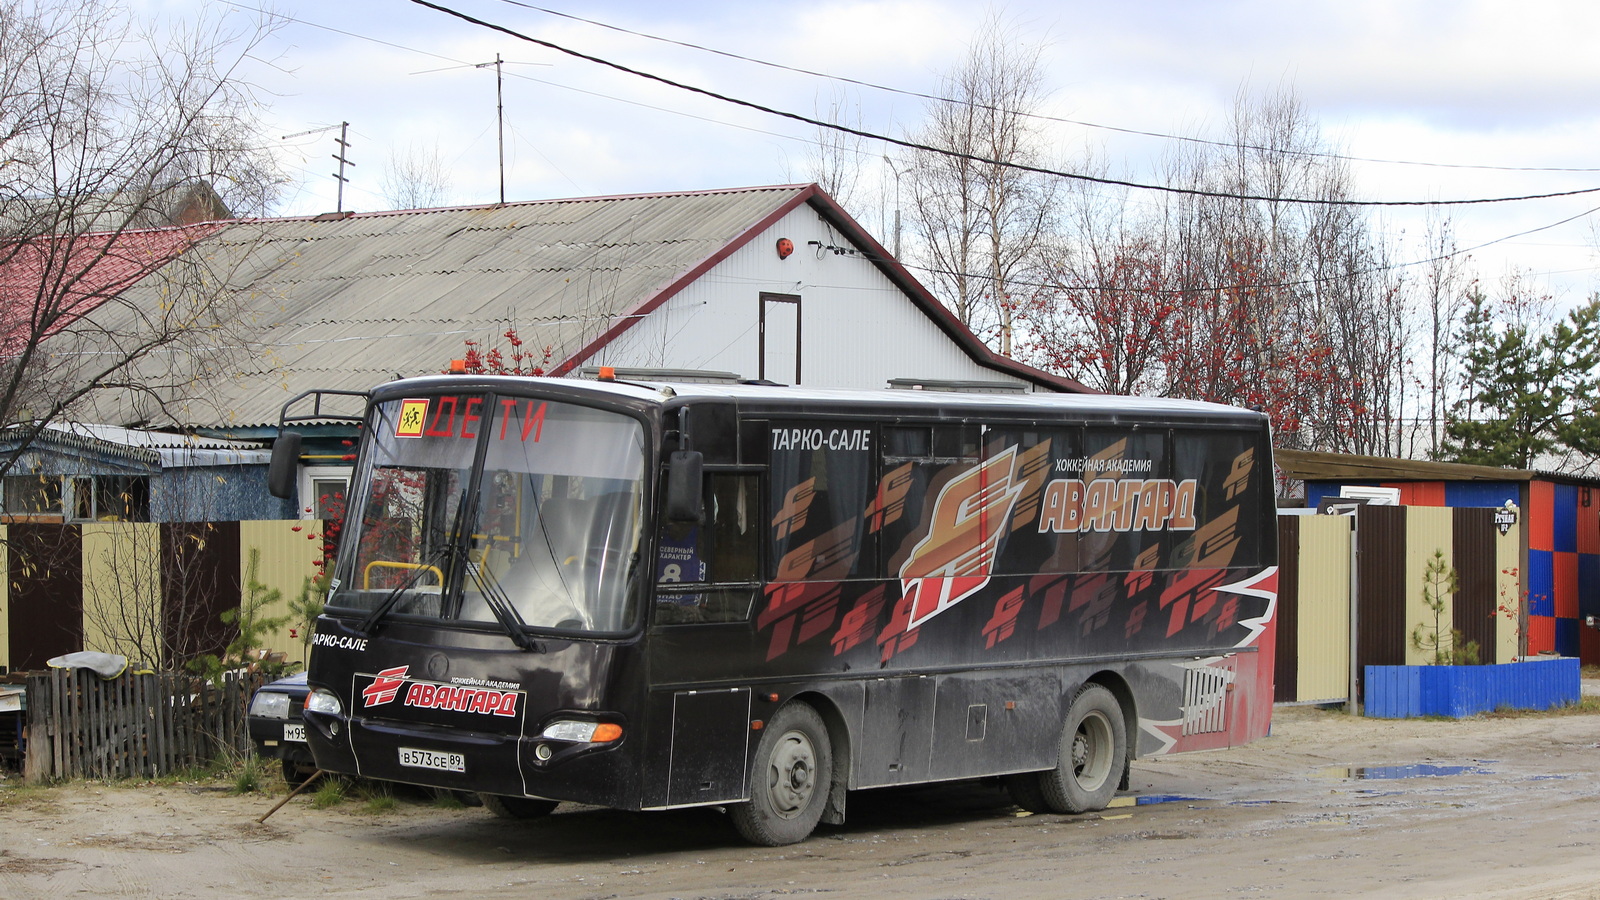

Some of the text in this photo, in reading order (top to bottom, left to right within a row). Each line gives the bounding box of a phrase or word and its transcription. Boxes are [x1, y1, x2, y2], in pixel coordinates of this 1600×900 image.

[425, 396, 548, 443] ДЕТИ
[772, 428, 871, 451] ТАРКО-САЛЕ
[1055, 456, 1152, 474] ХОККЕЙНАЯ АКАДЕМИЯ
[1038, 479, 1198, 533] АВАНГАРД
[660, 546, 694, 554] СЕВЕРНЫЙ
[660, 552, 692, 560] ХАРАКТЕР
[450, 676, 520, 690] ХОККЕЙНАЯ АКАДЕМИЯ
[404, 683, 518, 717] АВАНГАРД
